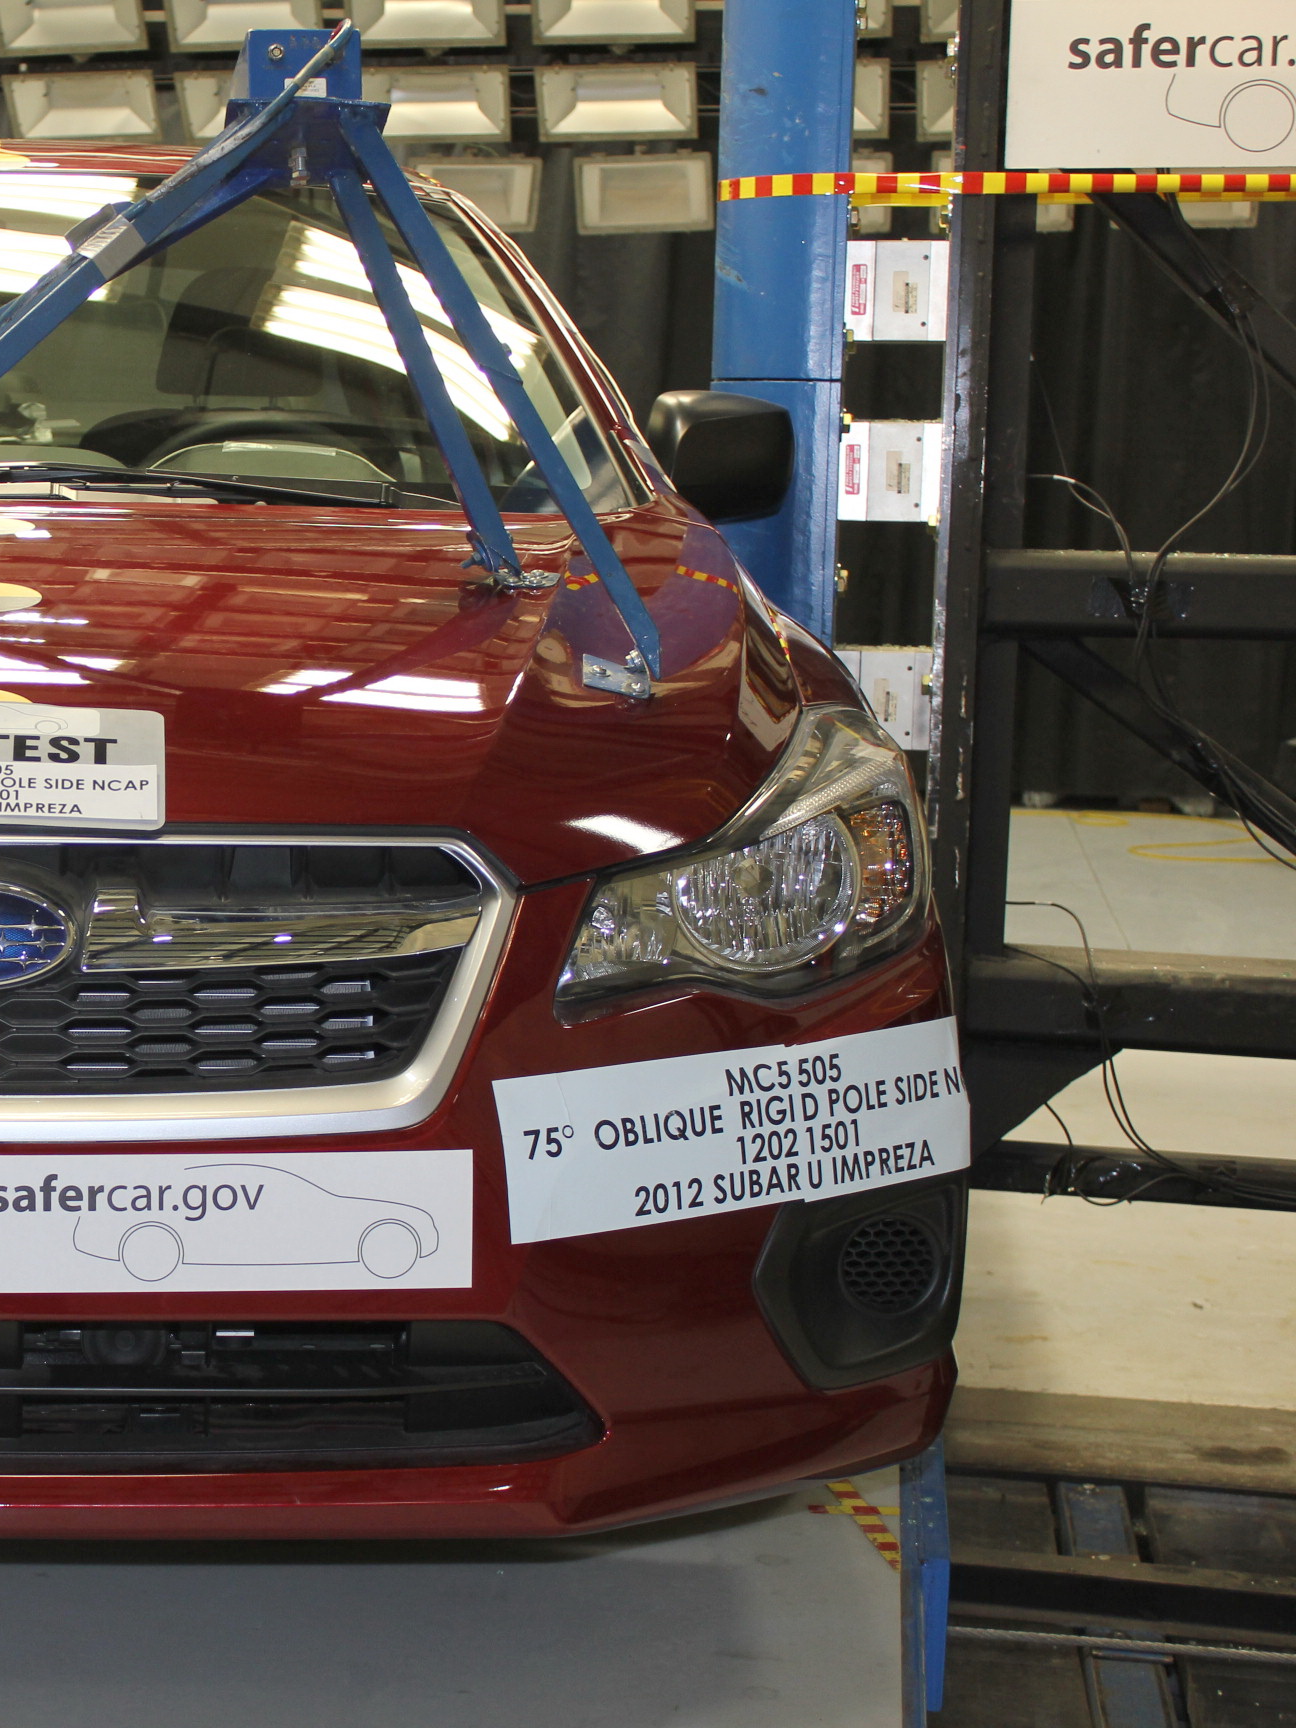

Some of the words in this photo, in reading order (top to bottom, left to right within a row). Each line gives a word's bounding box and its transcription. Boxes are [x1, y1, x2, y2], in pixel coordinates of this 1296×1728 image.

[44, 778, 85, 791] SIDE
[92, 779, 149, 792] NCAP
[594, 1103, 724, 1151] OBLIQUE
[740, 1092, 819, 1131] RIGID
[828, 1079, 889, 1117] POLE
[894, 1071, 940, 1107] SIDE
[943, 1065, 966, 1096] N
[634, 1177, 705, 1218] 2012
[712, 1159, 823, 1205] SUBARU
[832, 1138, 935, 1186] IMPREZA
